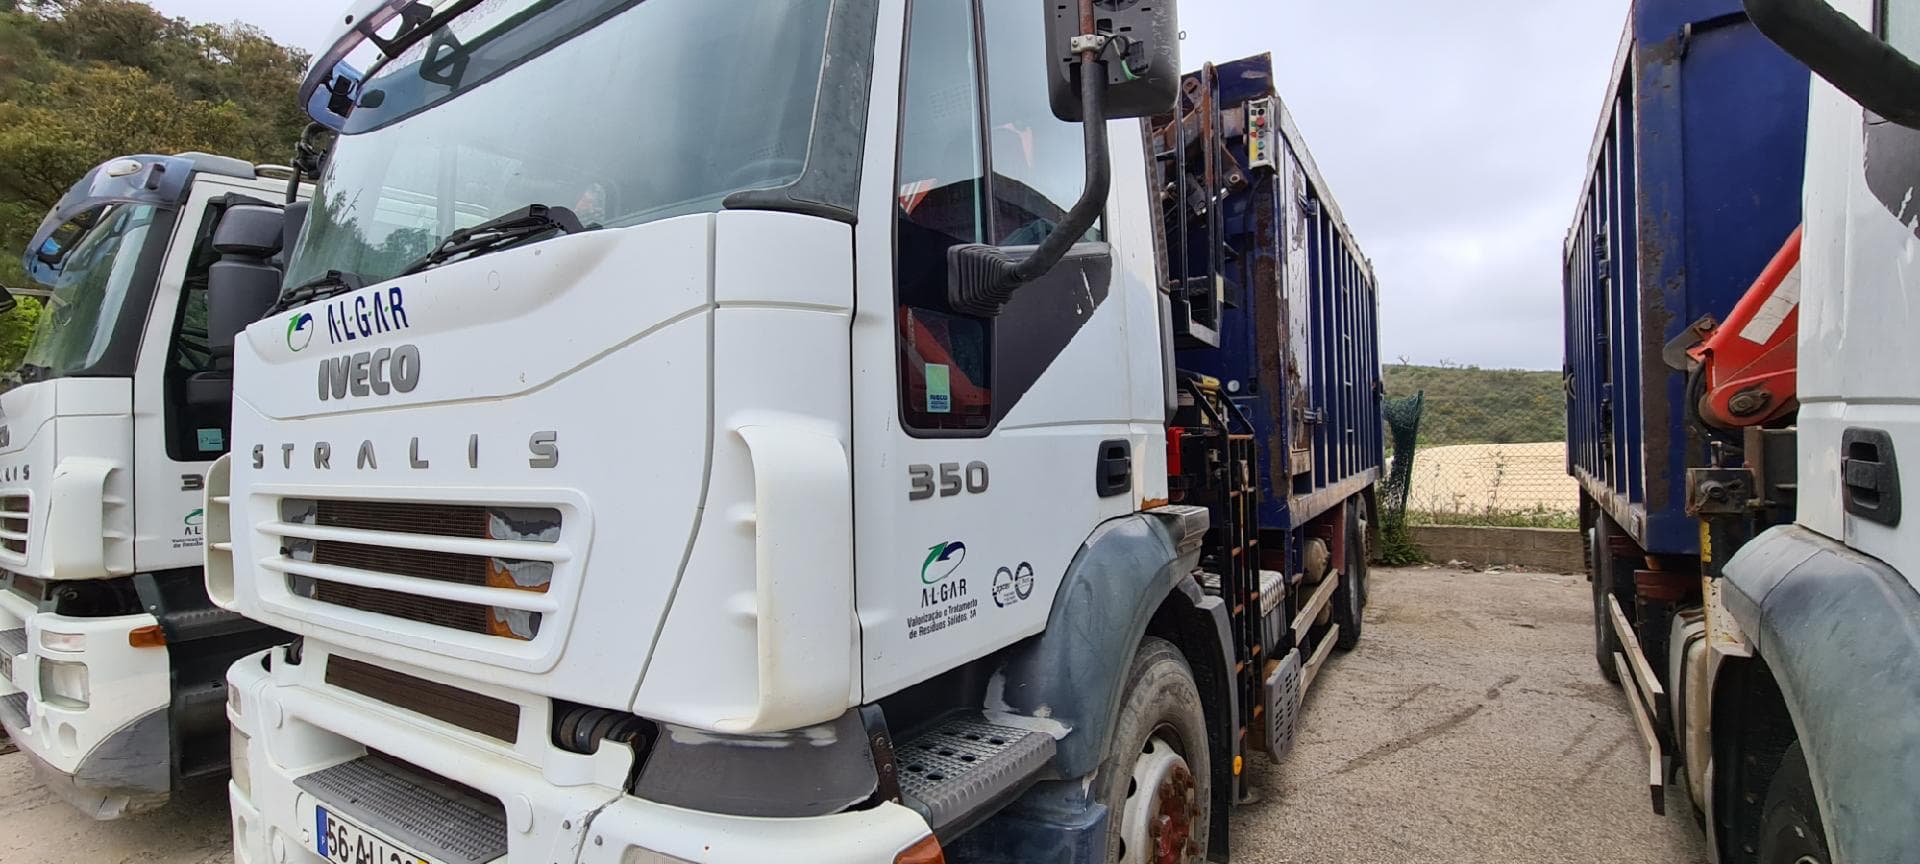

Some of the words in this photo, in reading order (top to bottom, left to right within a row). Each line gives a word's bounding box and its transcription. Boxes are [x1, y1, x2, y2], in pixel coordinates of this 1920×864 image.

[318, 344, 420, 401] IVECO
[252, 430, 559, 470] STRALIS
[909, 460, 989, 501] 350
[948, 598, 978, 614] Tratamento
[909, 629, 918, 640] de
